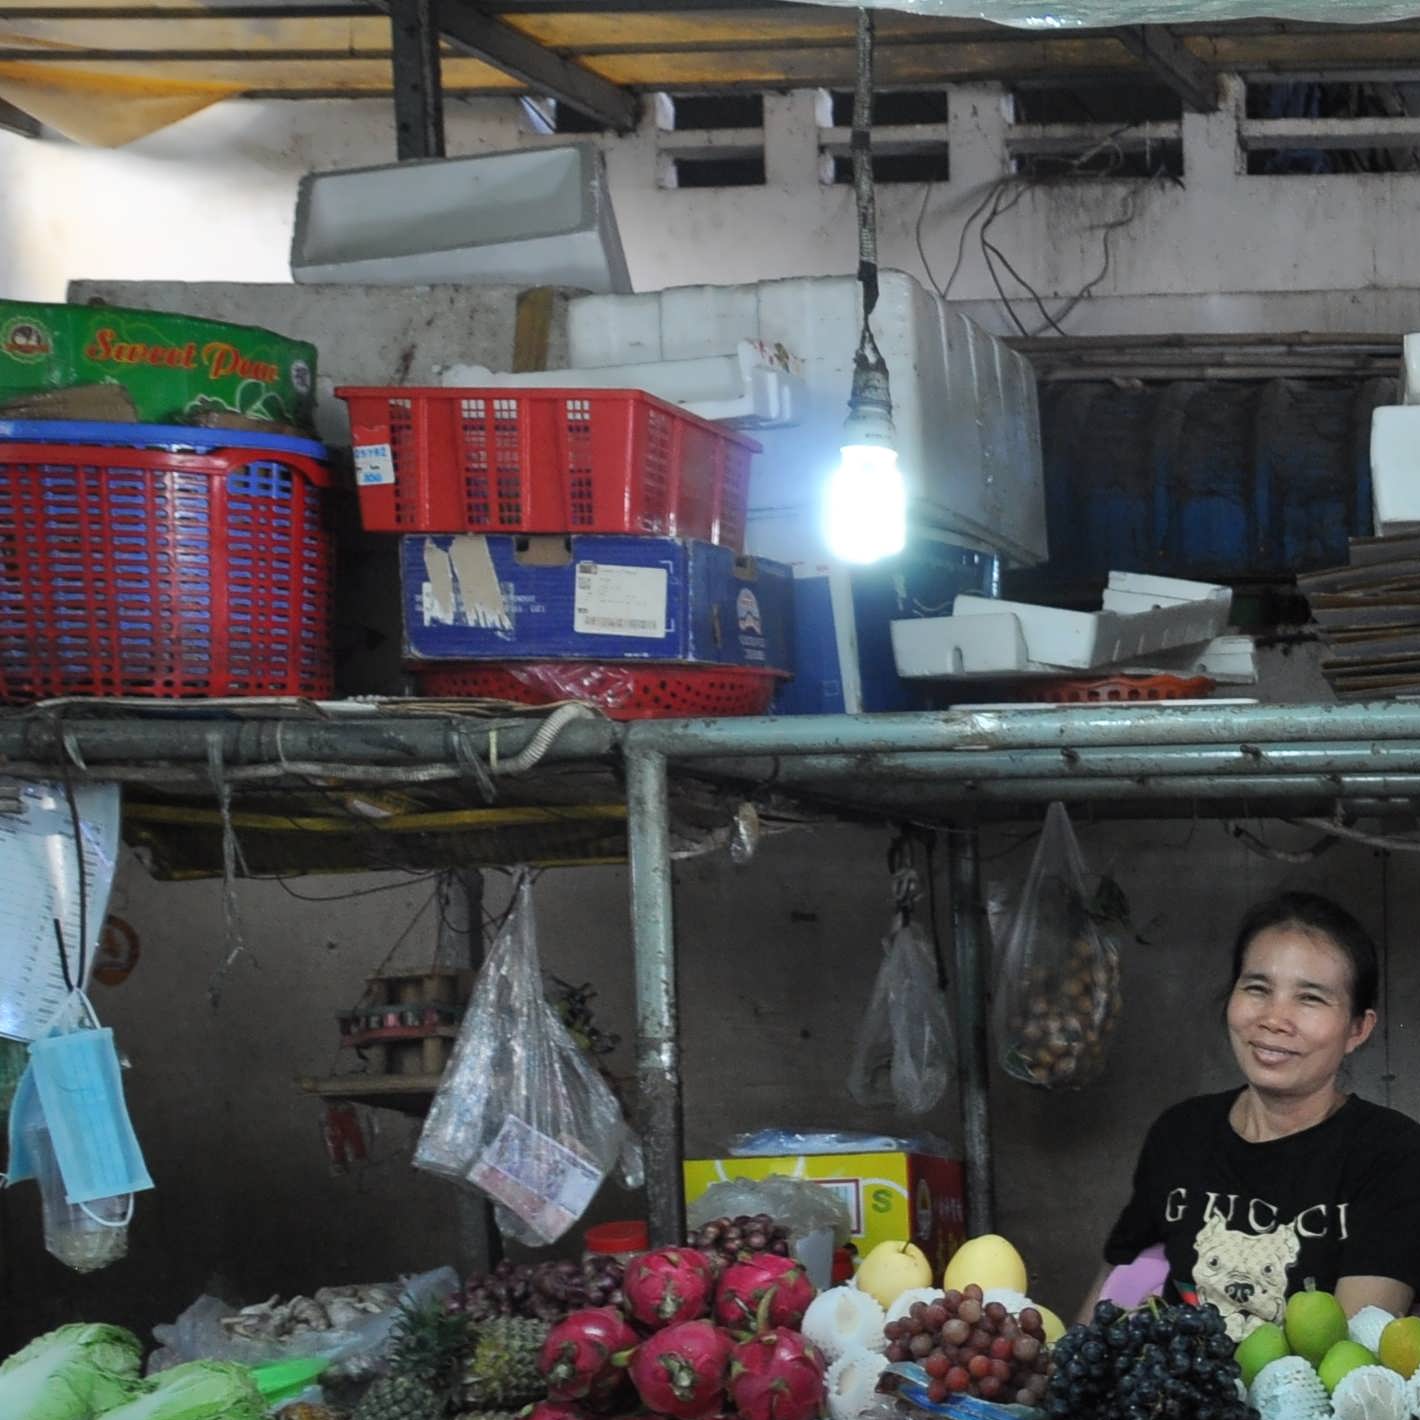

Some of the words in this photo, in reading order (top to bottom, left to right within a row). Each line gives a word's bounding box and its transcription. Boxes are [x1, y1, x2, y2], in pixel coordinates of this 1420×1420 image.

[86, 329, 197, 369] Sweet
[872, 1189, 892, 1213] S
[1165, 1187, 1350, 1240] GUCCI
